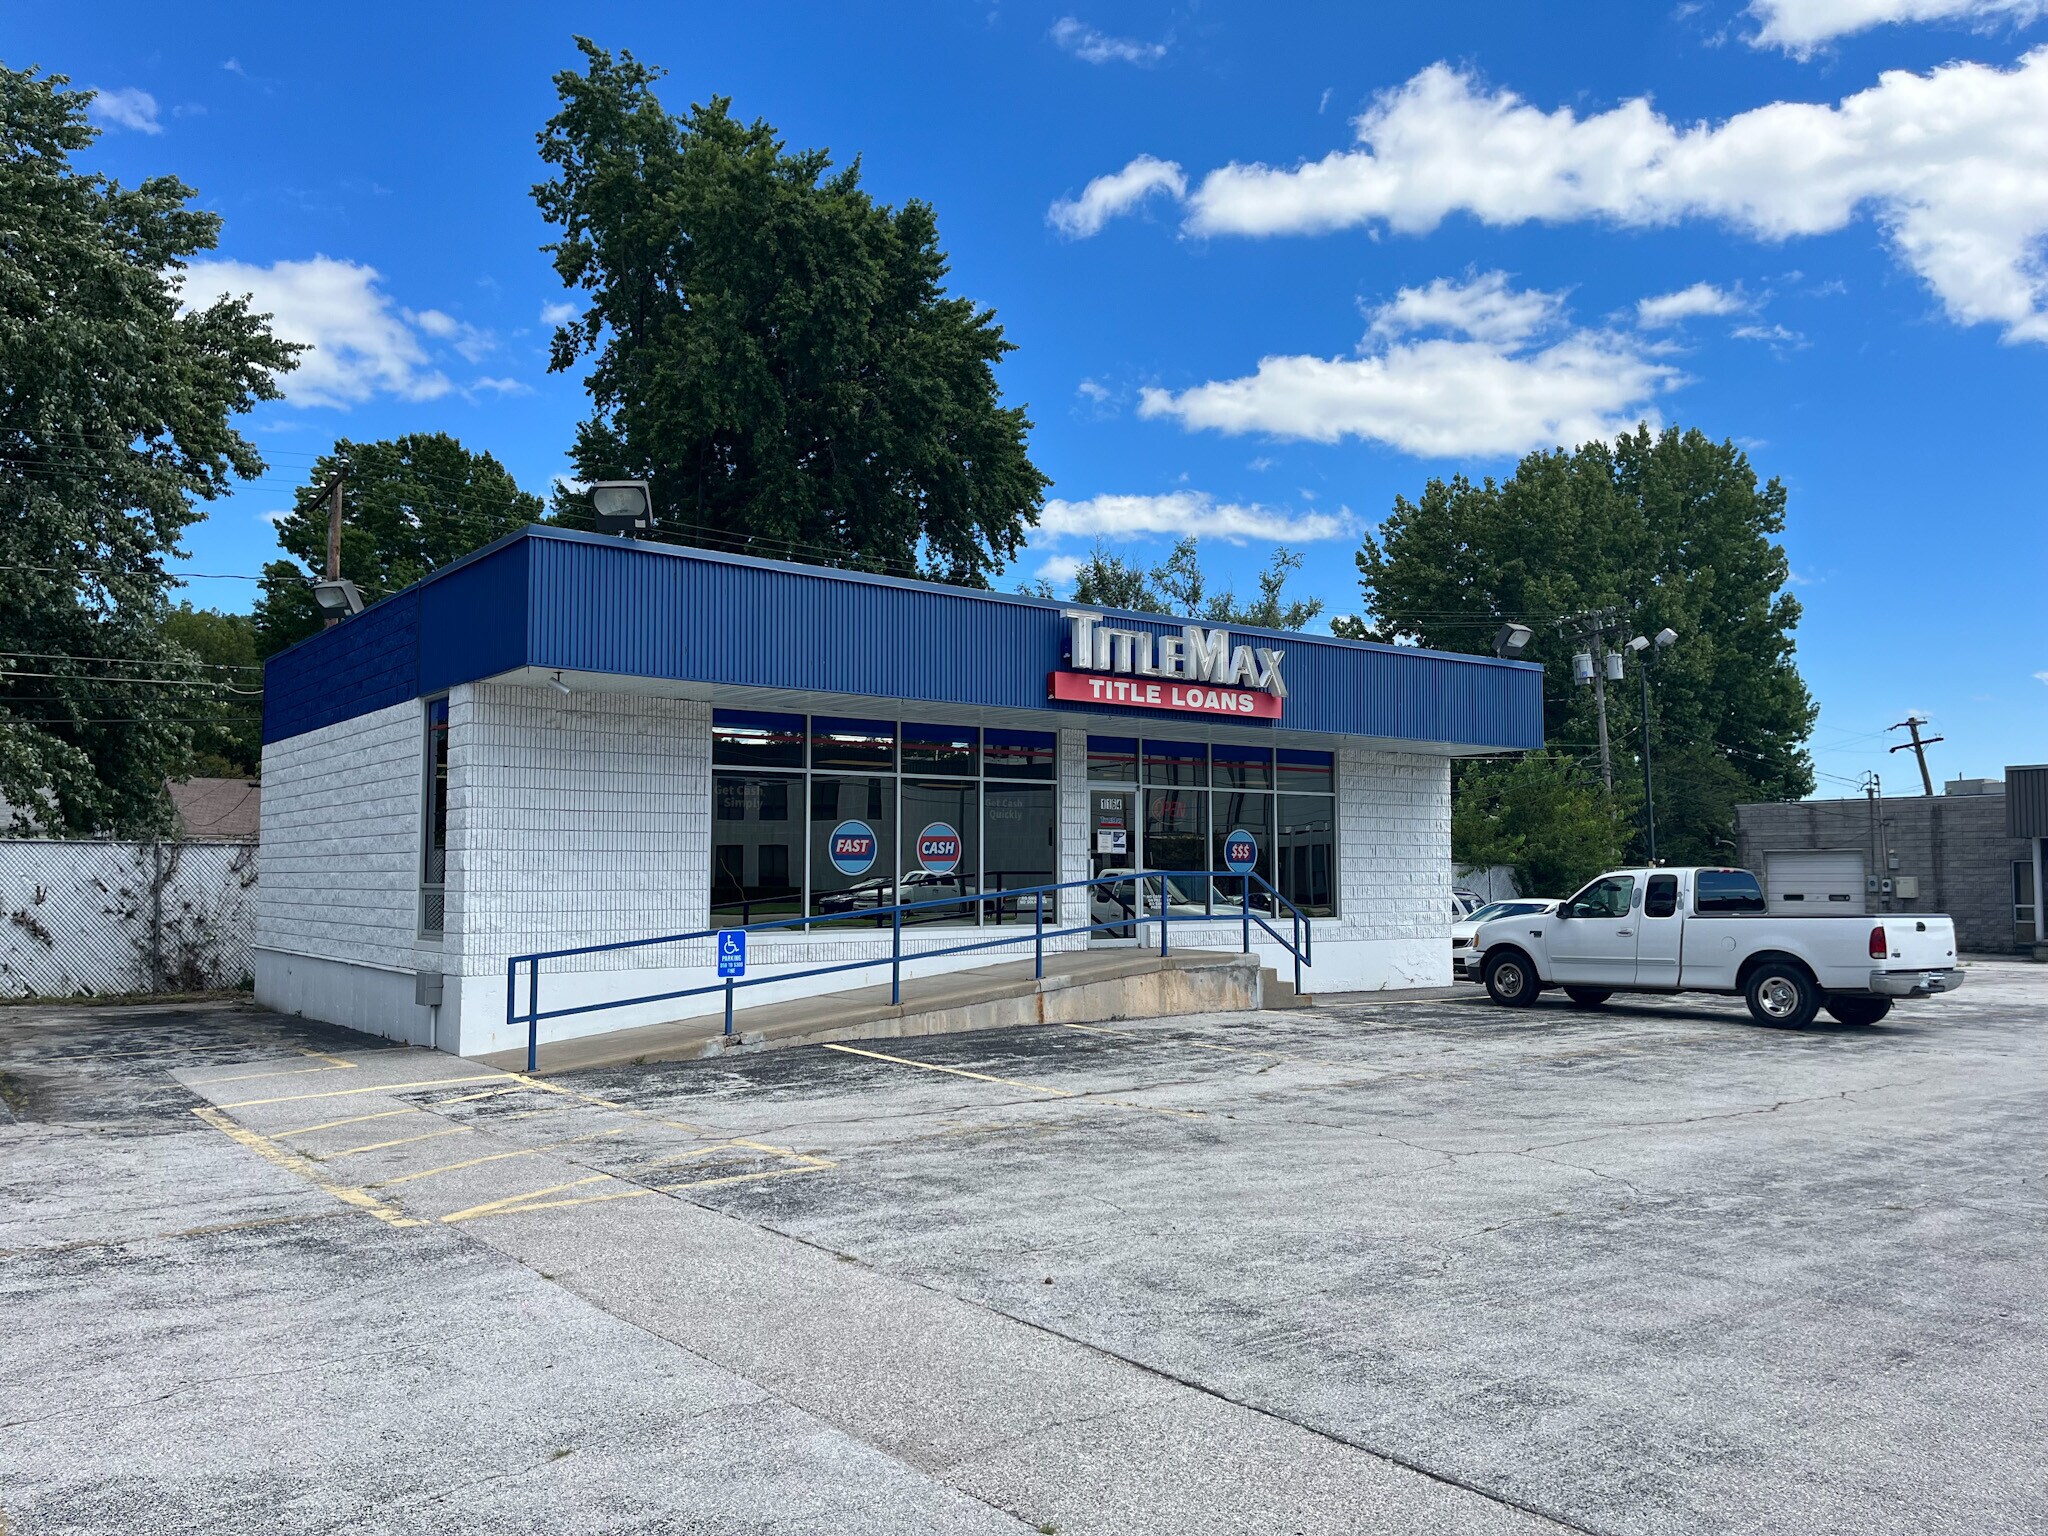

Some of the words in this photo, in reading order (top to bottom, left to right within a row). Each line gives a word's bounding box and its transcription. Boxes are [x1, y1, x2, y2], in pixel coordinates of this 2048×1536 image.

[1088, 679, 1162, 704] TITLE
[1171, 687, 1254, 713] LOANS
[724, 797, 763, 810] Simply
[1152, 799, 1186, 818] OPEN
[990, 809, 1023, 821] Quickly
[836, 839, 869, 853] FAST
[921, 841, 955, 855] CASH
[1231, 844, 1251, 859] $$$
